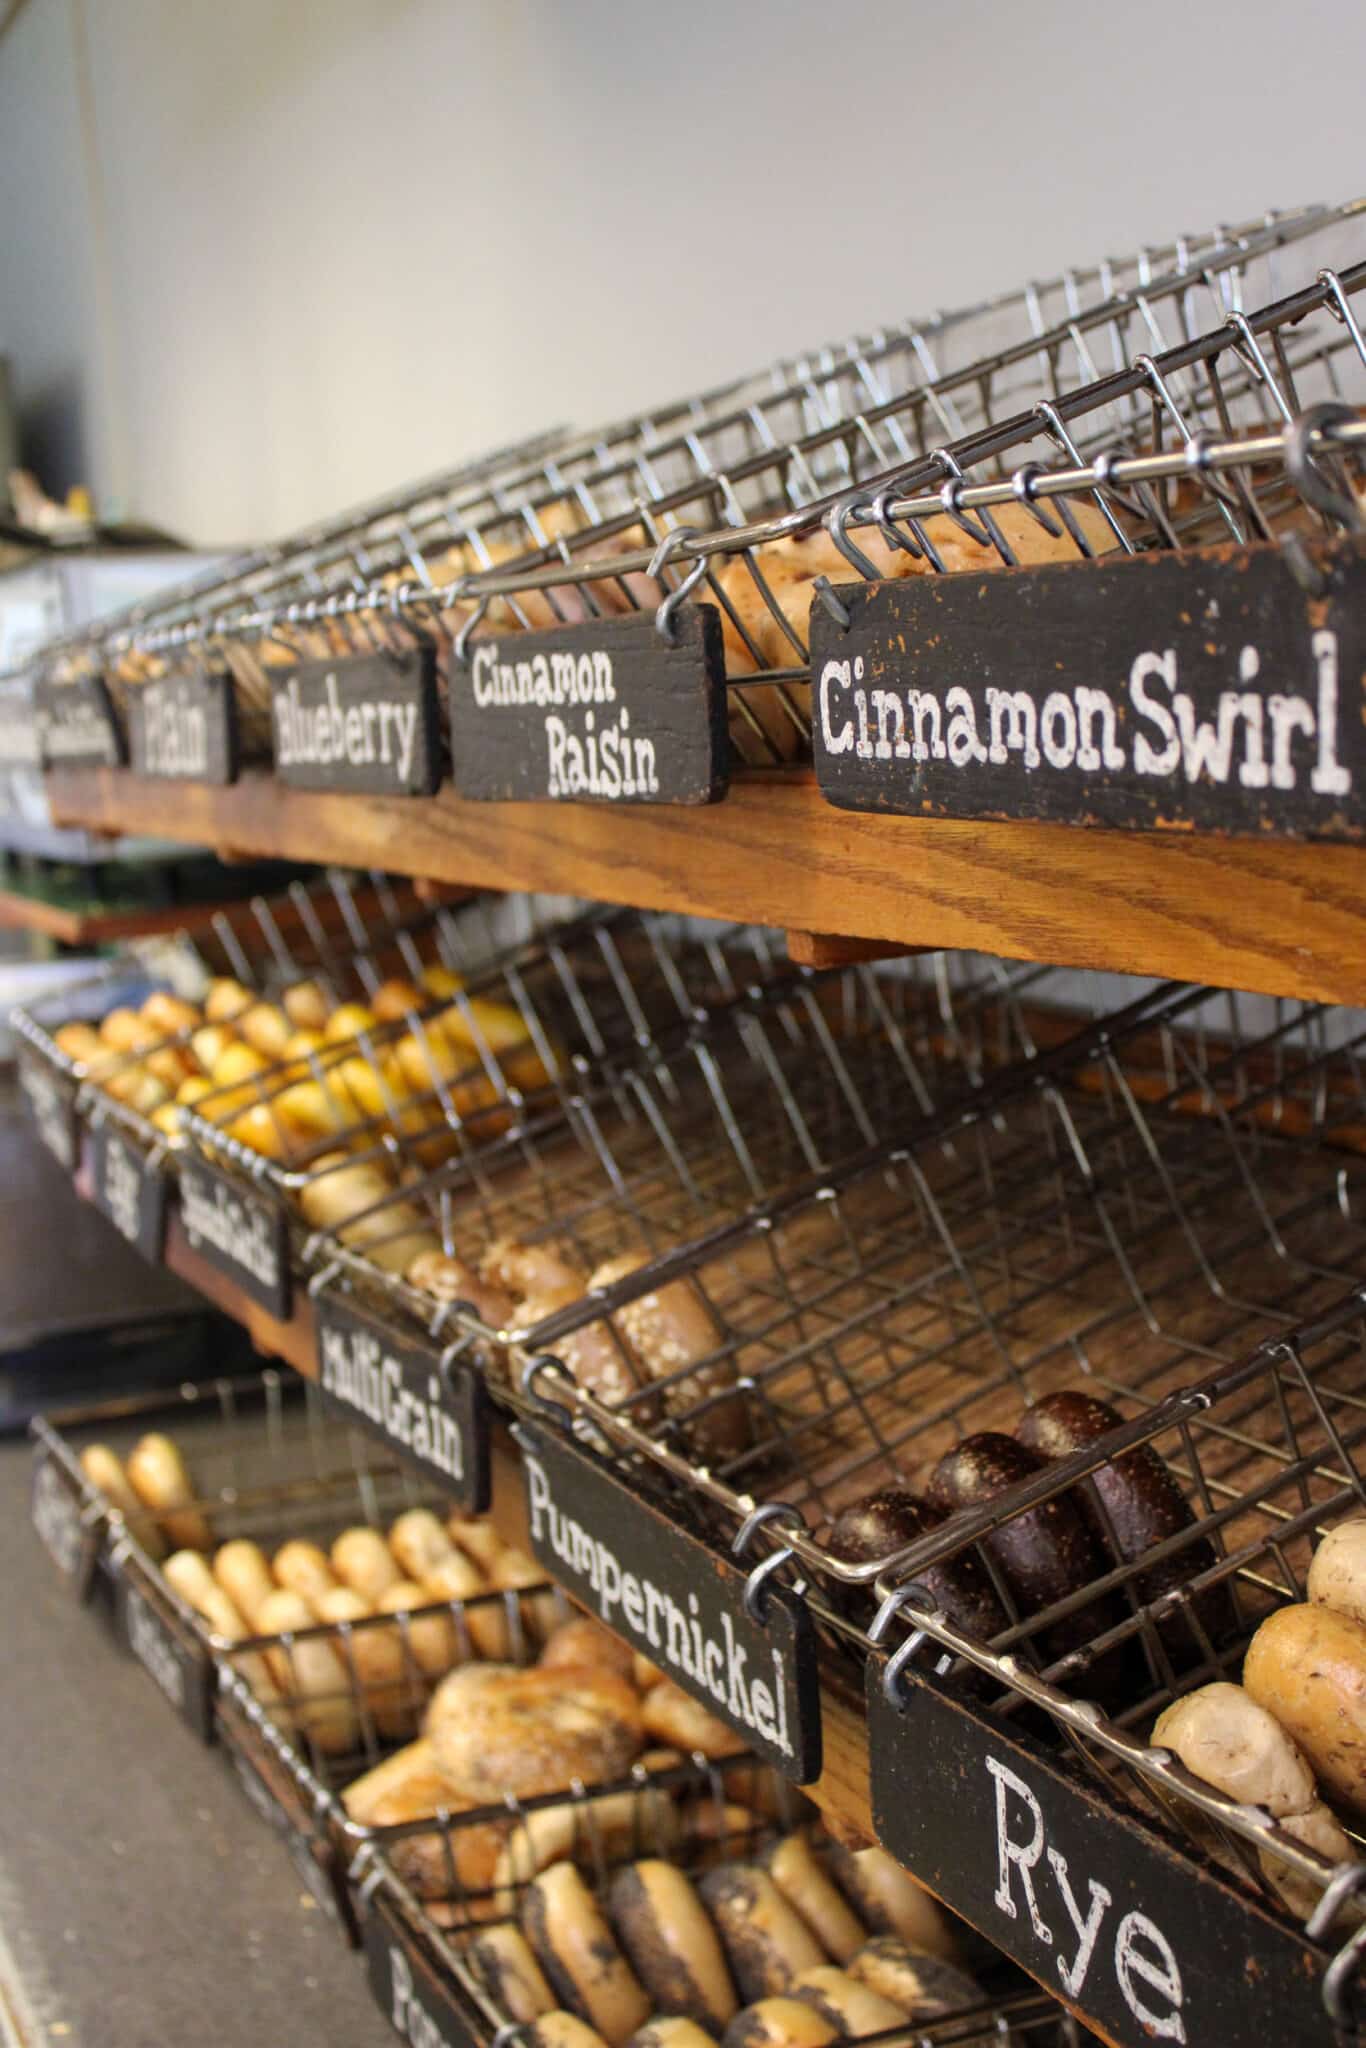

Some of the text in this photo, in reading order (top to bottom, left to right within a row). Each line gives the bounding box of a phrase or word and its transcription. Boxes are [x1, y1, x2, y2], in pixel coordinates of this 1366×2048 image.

[272, 672, 419, 784] Blueberry
[472, 644, 616, 708] Cinnamon
[819, 629, 1353, 796] Cinnamon Swirl
[545, 706, 660, 799] Raisin
[524, 1453, 795, 1759] Pumpernickel
[984, 1754, 1188, 2047] Rye
